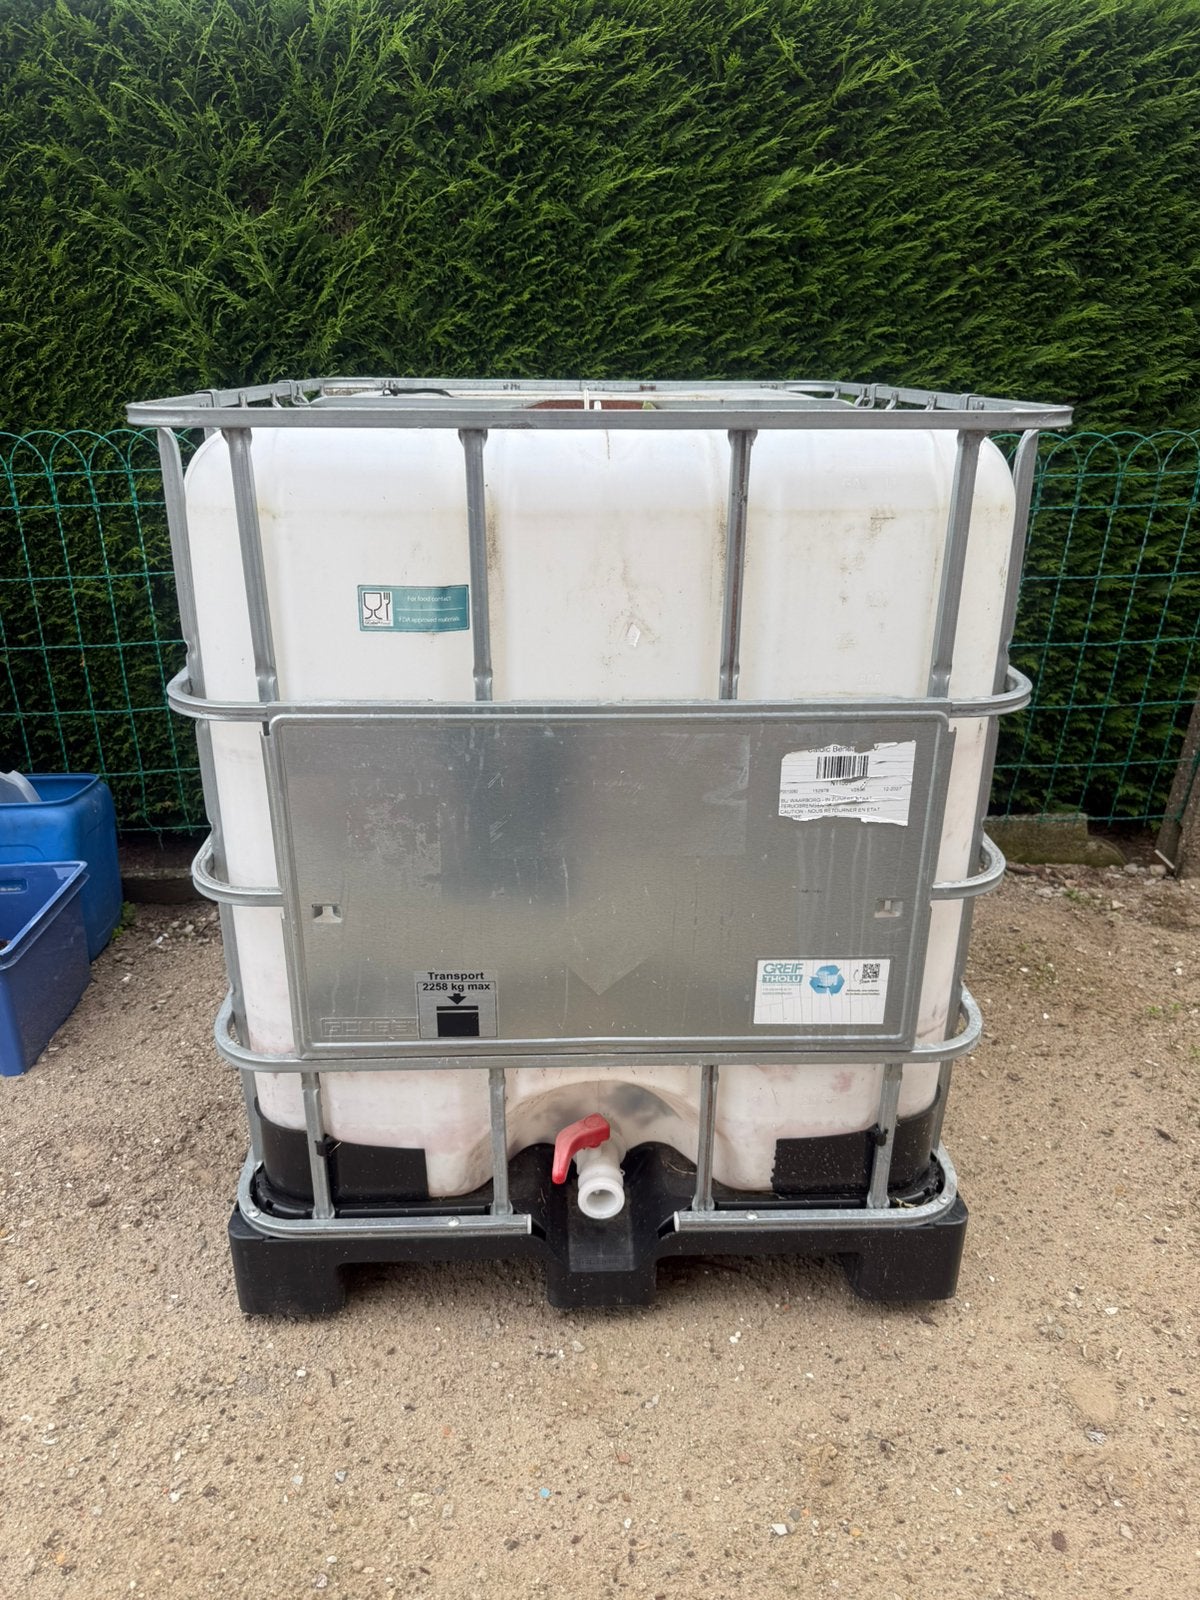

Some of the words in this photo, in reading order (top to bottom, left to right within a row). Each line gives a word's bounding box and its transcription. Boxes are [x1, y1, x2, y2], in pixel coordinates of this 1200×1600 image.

[411, 616, 437, 624] approved
[763, 962, 804, 974] GREIF
[427, 971, 485, 982] Transport
[764, 974, 802, 983] THOLU
[422, 982, 448, 991] 2258
[451, 982, 465, 992] kg
[467, 983, 491, 991] max
